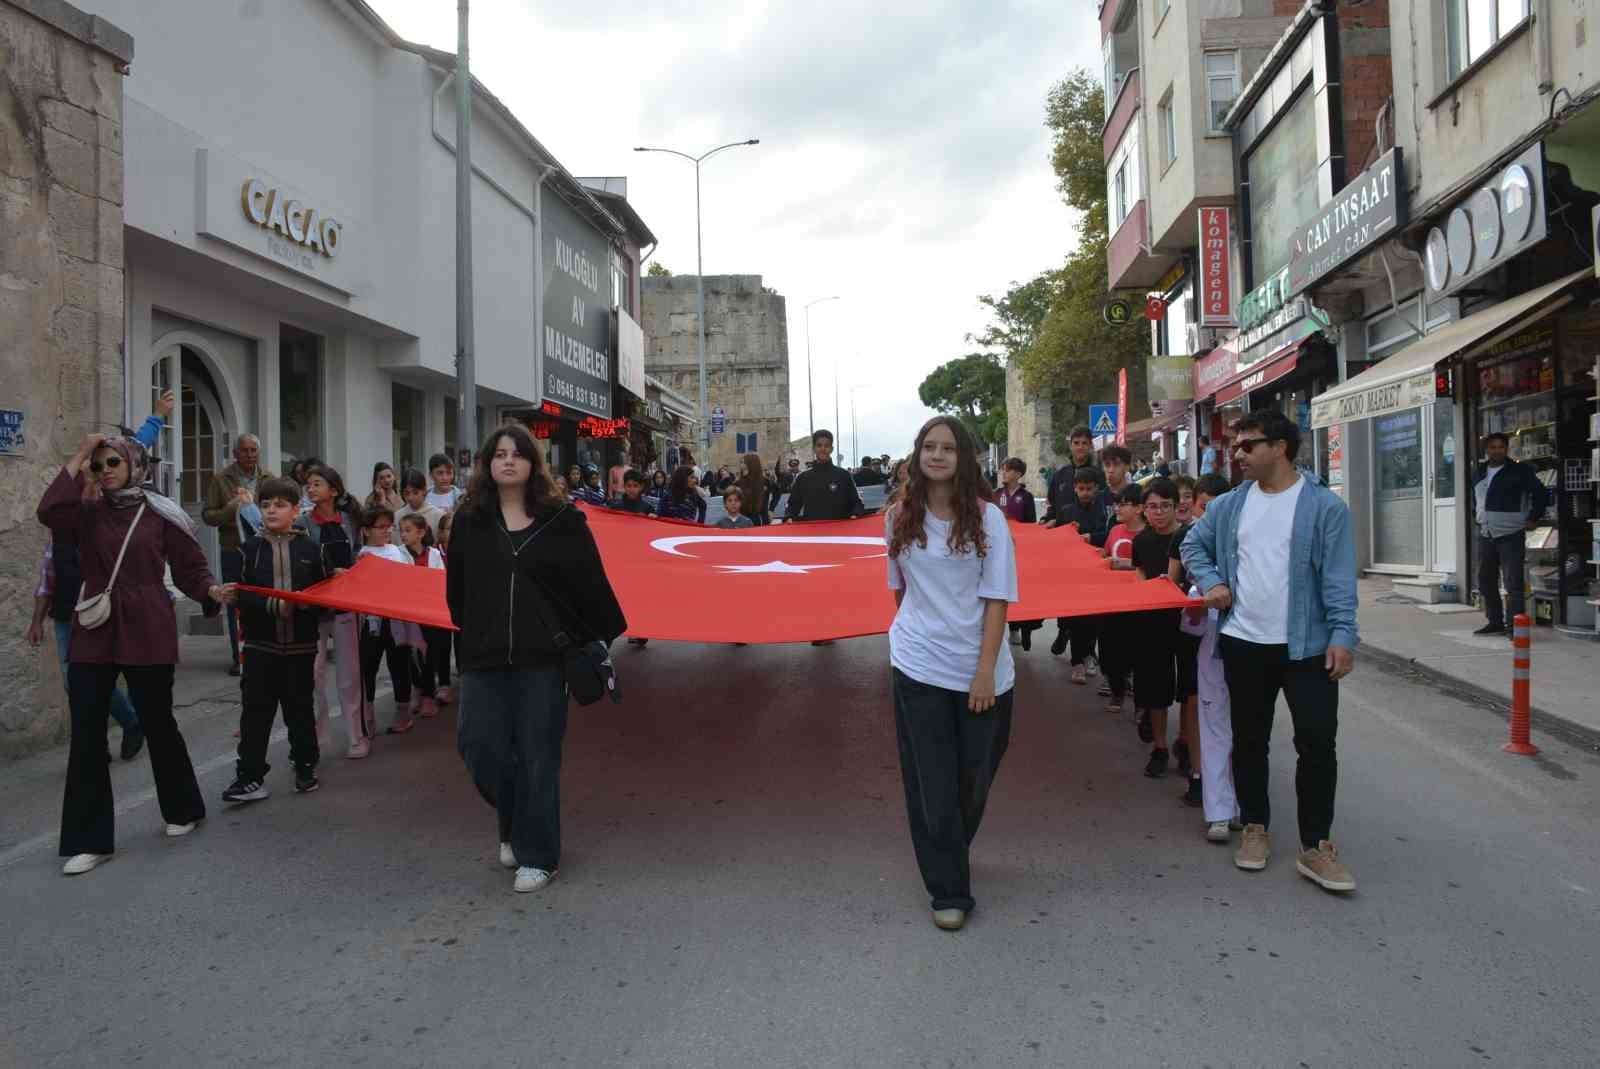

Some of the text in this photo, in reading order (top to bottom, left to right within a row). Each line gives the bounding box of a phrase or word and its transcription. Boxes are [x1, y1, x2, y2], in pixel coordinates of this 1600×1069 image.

[241, 177, 338, 258] CACAO
[1306, 165, 1391, 254] CAN İNŞAAT
[555, 236, 599, 293] KULOĞLU
[1206, 211, 1224, 313] komagene
[1344, 223, 1369, 254] CAN
[571, 295, 585, 328] AV
[545, 325, 608, 382] MALZEMELERİ
[1367, 383, 1402, 411] MARKET
